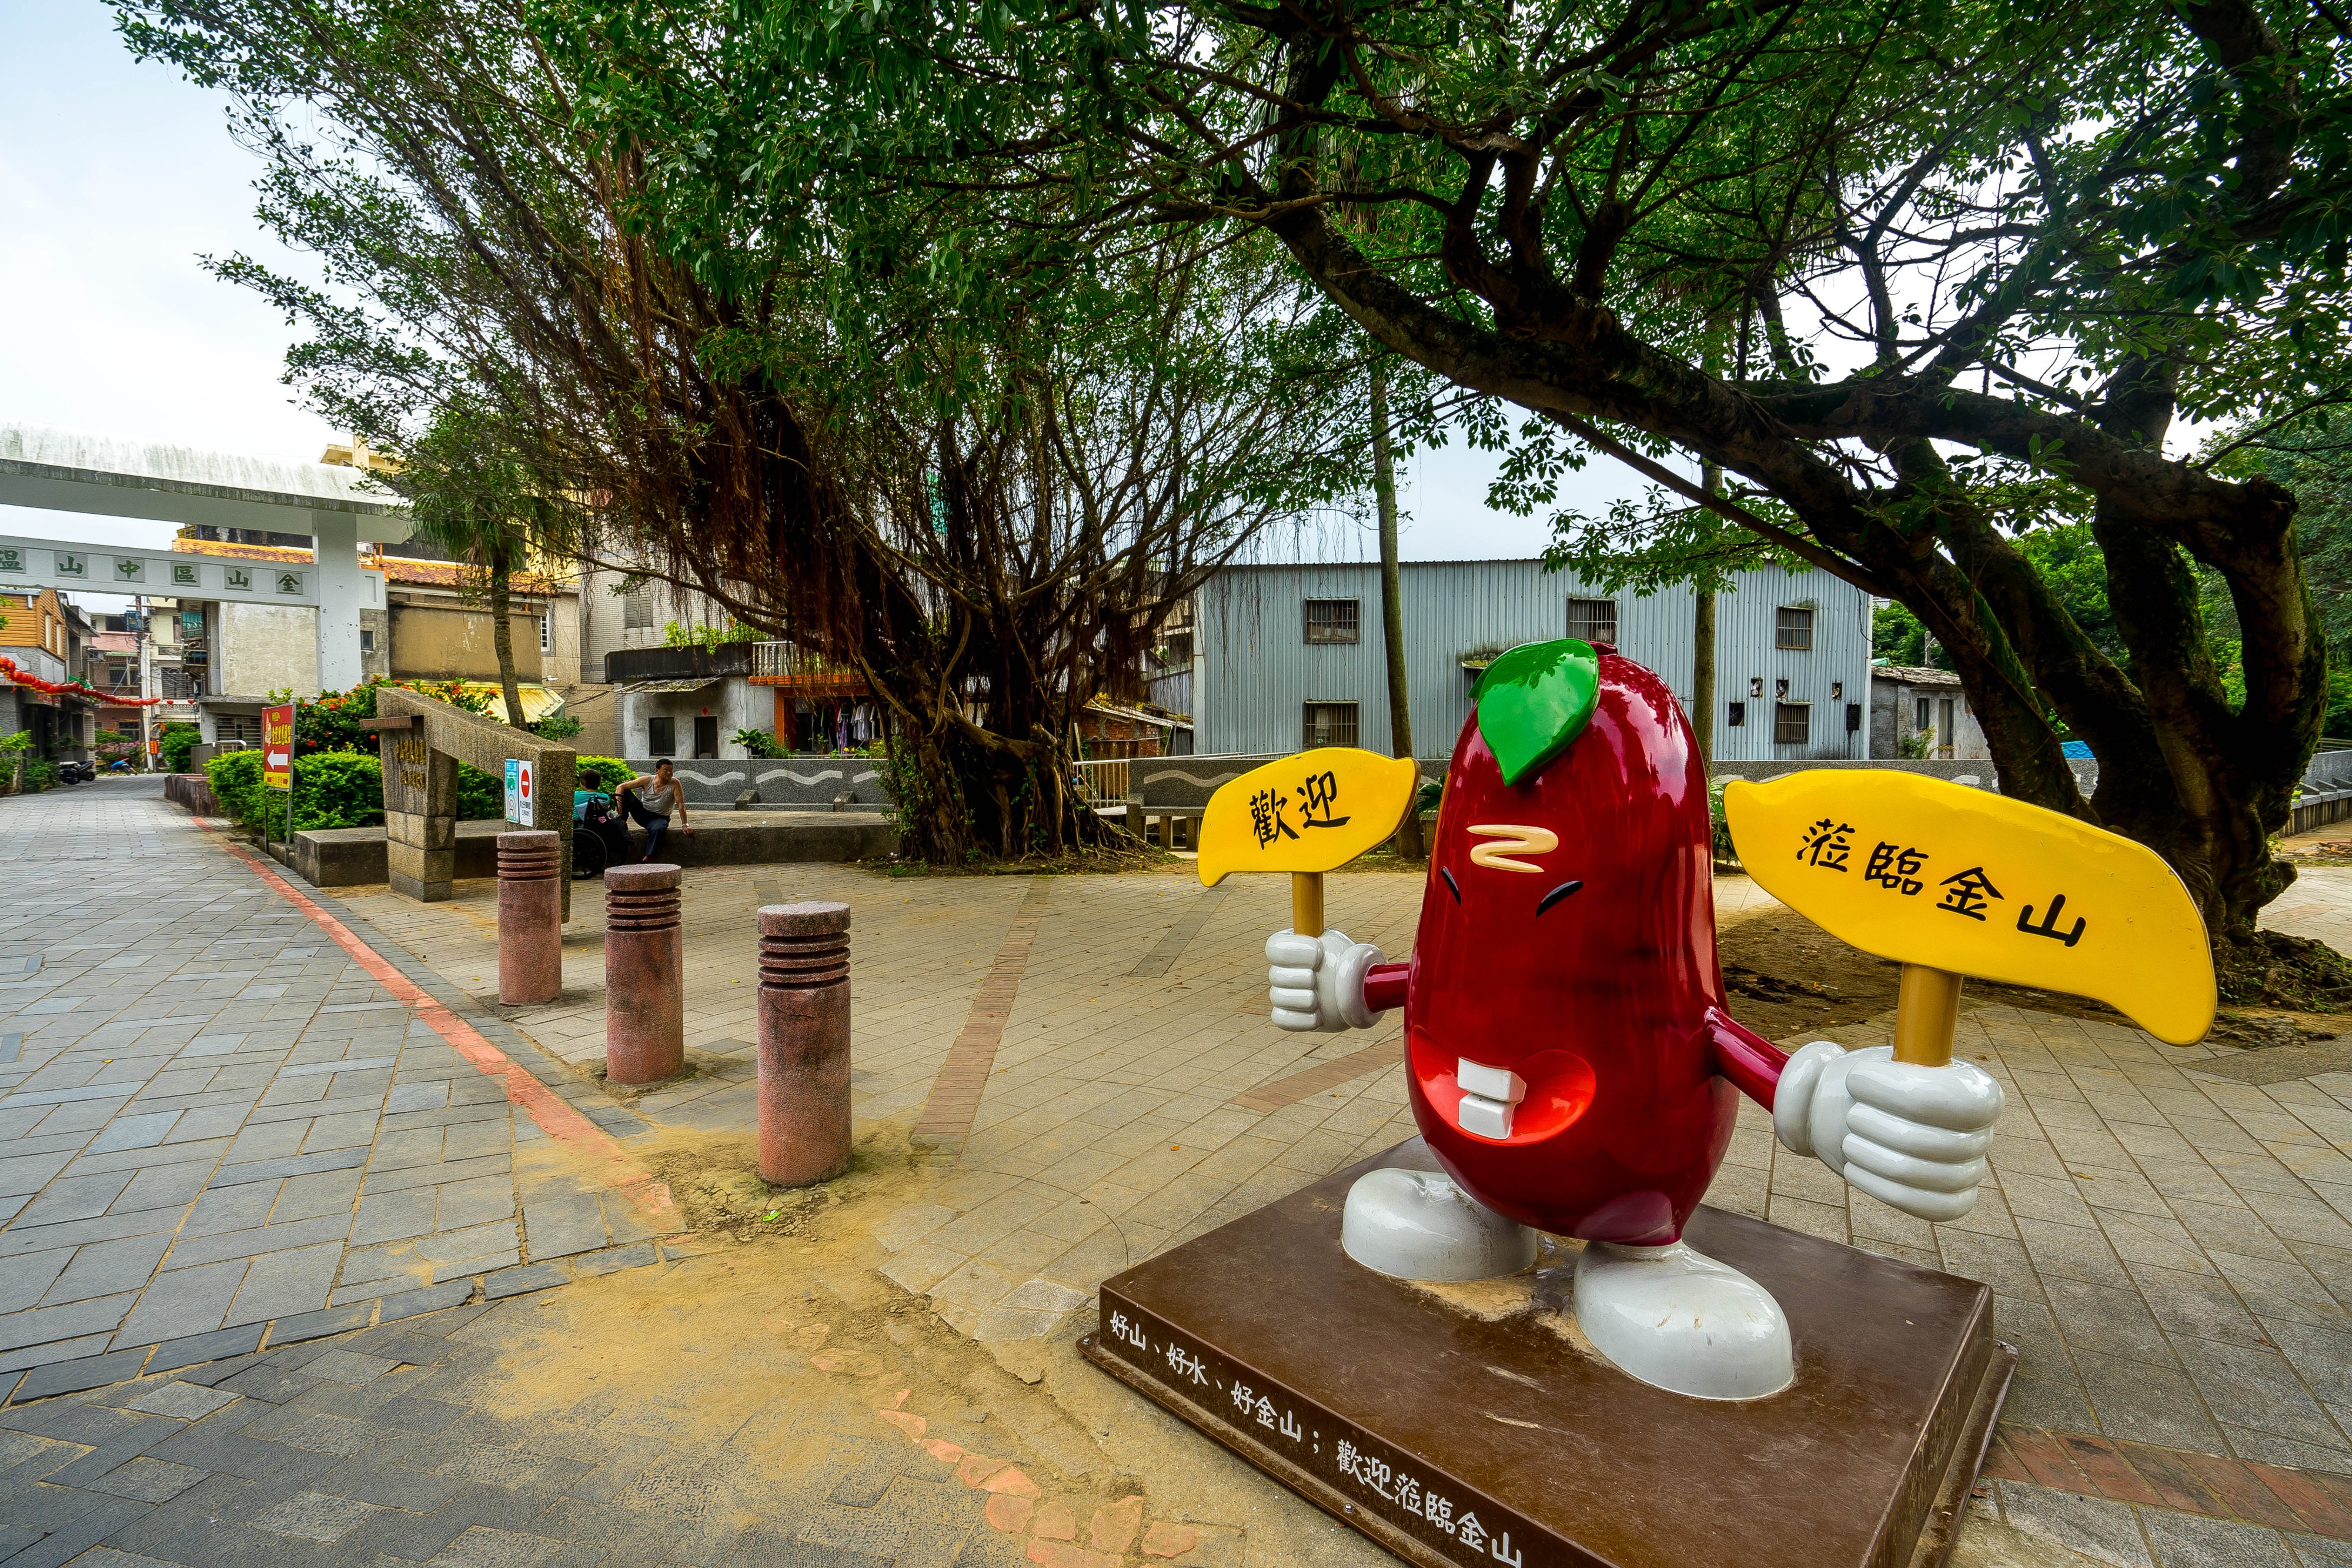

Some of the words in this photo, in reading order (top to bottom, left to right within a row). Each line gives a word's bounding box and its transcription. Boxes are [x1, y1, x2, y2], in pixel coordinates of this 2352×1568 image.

[1250, 771, 1351, 850] 歡迎
[1796, 818, 2086, 947] 蒞臨金山
